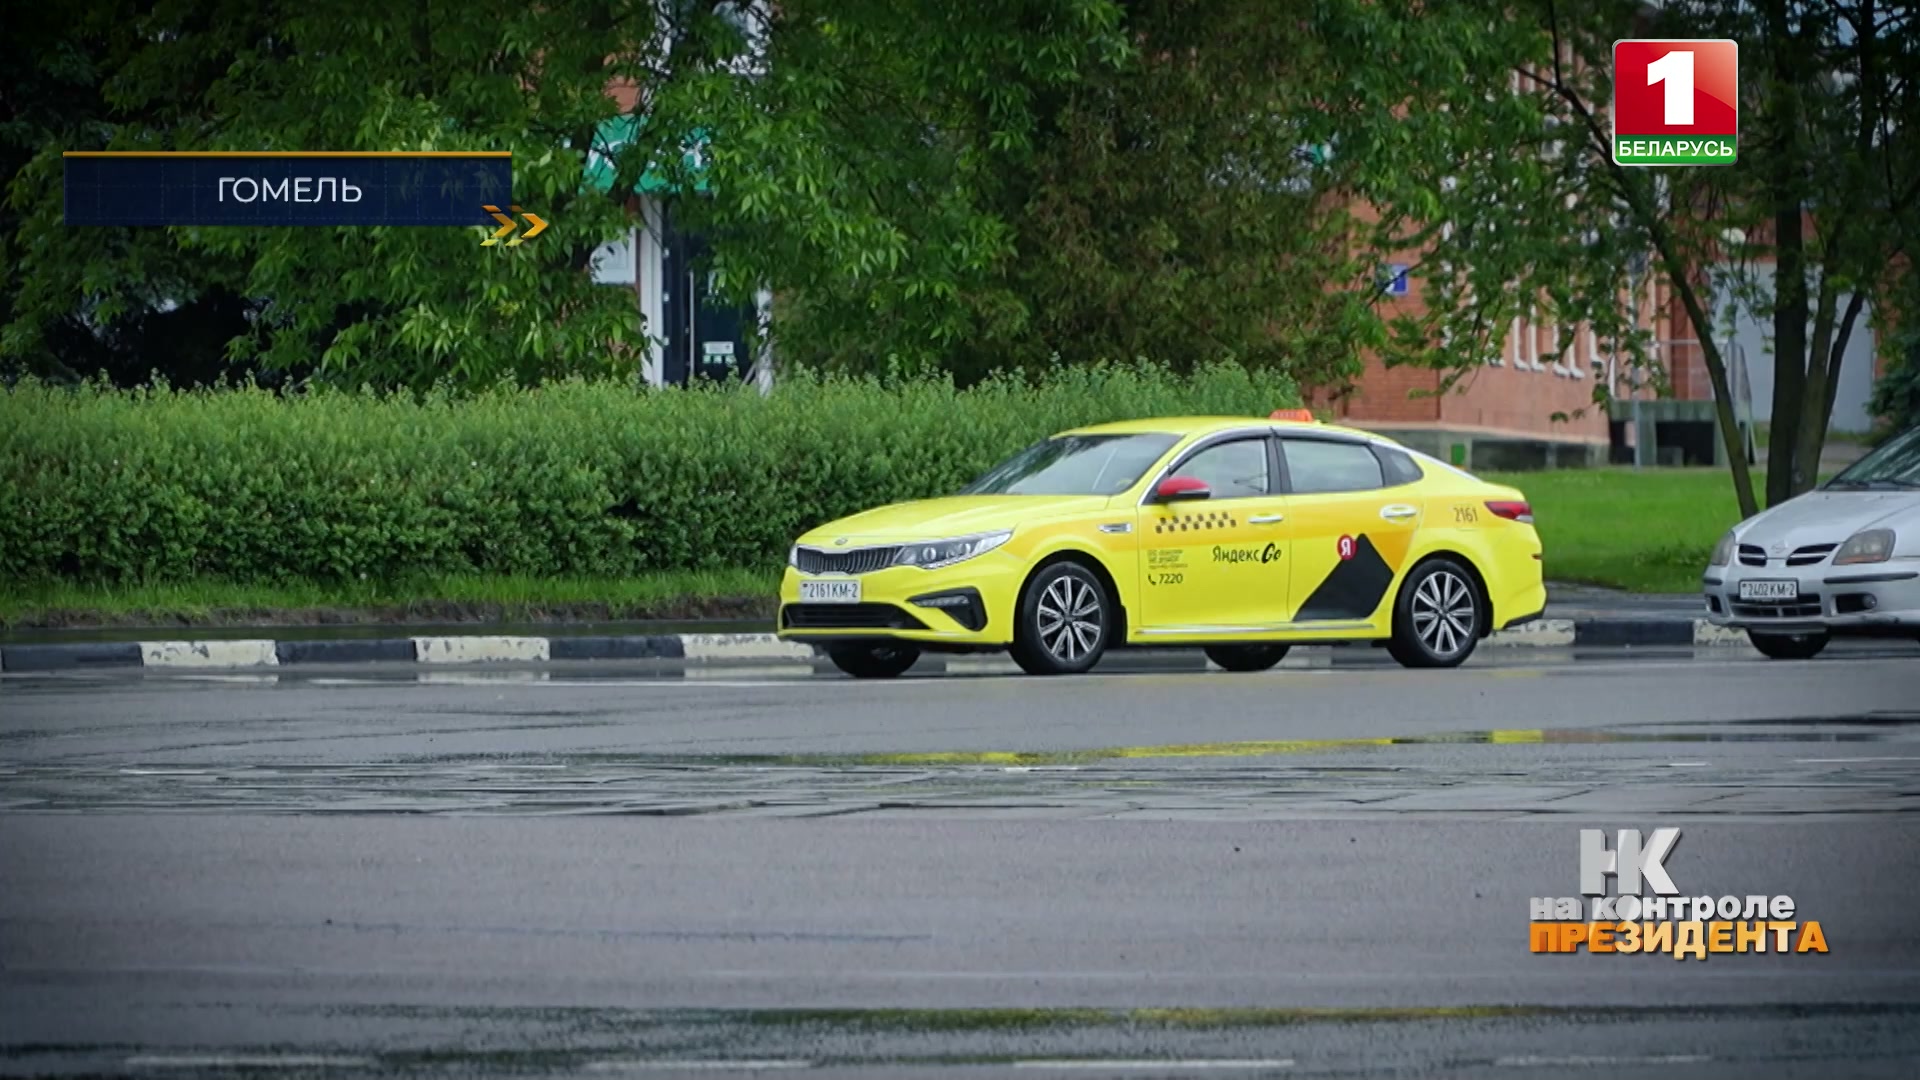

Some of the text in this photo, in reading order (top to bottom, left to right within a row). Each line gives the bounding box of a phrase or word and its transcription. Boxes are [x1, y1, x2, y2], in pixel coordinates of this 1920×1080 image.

[1453, 507, 1478, 522] 2161
[1212, 542, 1282, 564] Яндекс Go
[1340, 538, 1351, 556] Я
[1159, 573, 1184, 584] 7220
